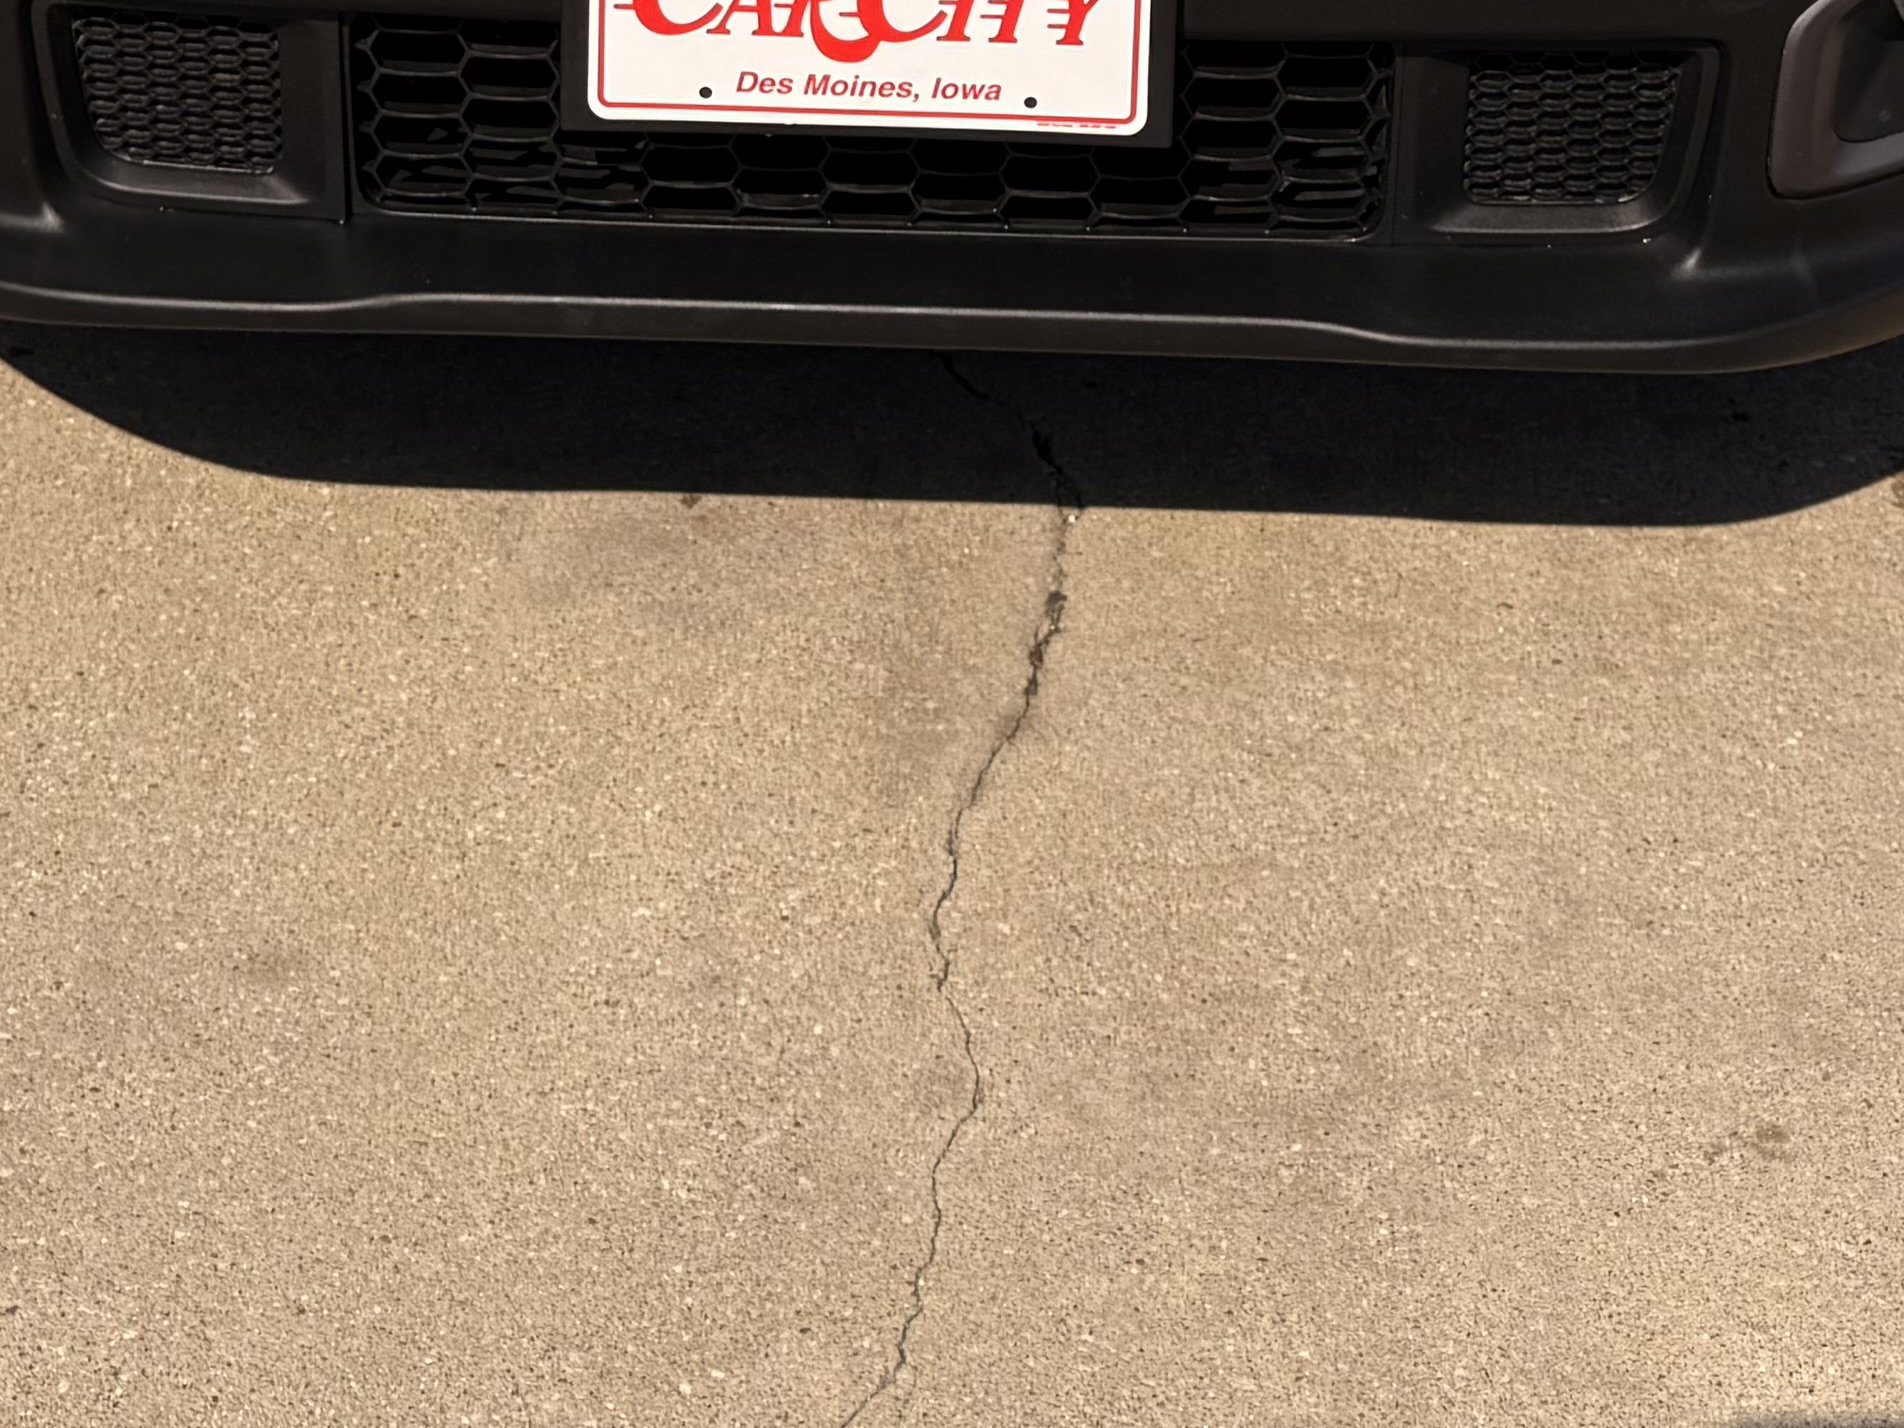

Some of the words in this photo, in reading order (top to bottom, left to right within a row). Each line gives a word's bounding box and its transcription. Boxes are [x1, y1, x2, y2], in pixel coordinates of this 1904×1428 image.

[736, 71, 794, 95] Des
[804, 74, 921, 102] Moines,
[932, 77, 1003, 101] Iowa
